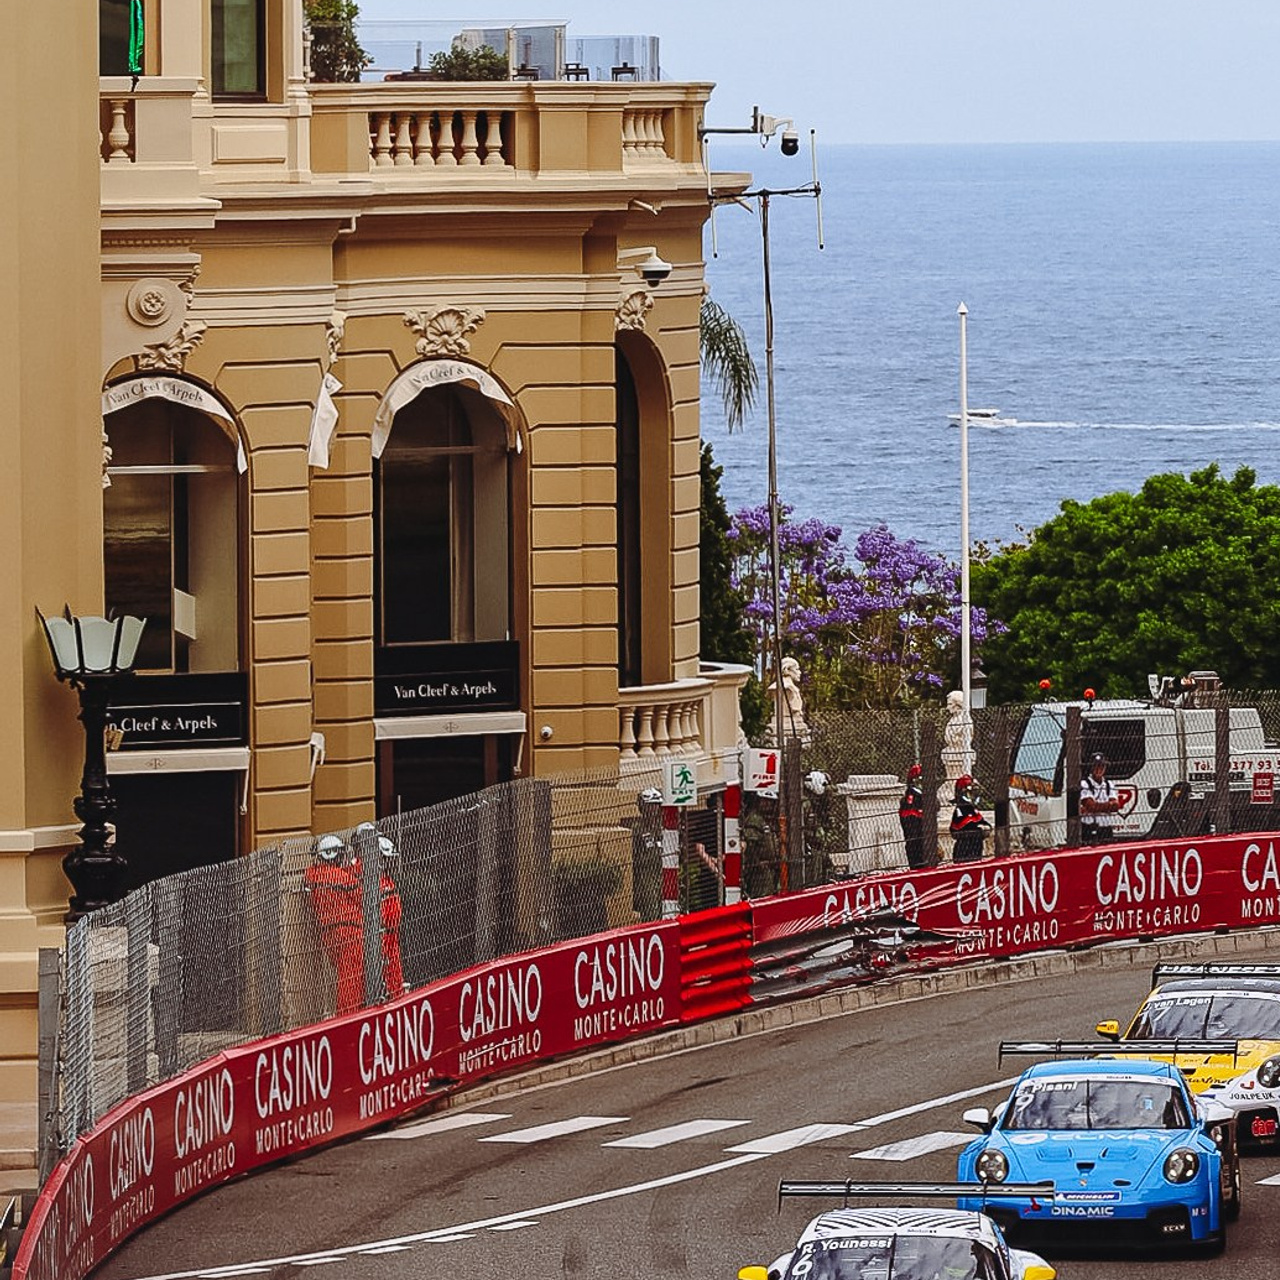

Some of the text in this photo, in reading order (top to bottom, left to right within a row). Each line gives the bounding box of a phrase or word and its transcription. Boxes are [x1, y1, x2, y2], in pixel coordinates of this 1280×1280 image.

[393, 681, 497, 699] Van Cleef & Arpels
[121, 717, 159, 732] Cleef
[161, 720, 172, 731] &
[173, 715, 218, 734] Arpels
[1229, 760, 1253, 770] 377
[1257, 760, 1272, 770] 93
[957, 862, 1060, 924] CASINO
[1095, 848, 1202, 906] CASINO
[1013, 919, 1060, 946] CARLO
[1094, 903, 1201, 931] MONTE CARLO
[574, 933, 665, 1009] CASINO
[459, 963, 542, 1042] CASINO
[574, 997, 665, 1041] MONTE CARLO
[1154, 999, 1174, 1008] van
[1176, 997, 1212, 1007] Lagen
[359, 1000, 434, 1085] CASINO
[500, 1029, 541, 1062] CARLO
[255, 1035, 332, 1119] CASINO
[1033, 1081, 1078, 1093] Pisani
[175, 1069, 234, 1159] CASINO
[359, 1083, 396, 1120] MONTE
[256, 1107, 333, 1154] MONTE CARLO
[110, 1107, 155, 1200] CASINO
[174, 1142, 235, 1197] MONTE CARLO
[1051, 1206, 1115, 1216] DINAMIC
[792, 1254, 814, 1276] 6
[802, 1237, 894, 1256] R. Younessi
